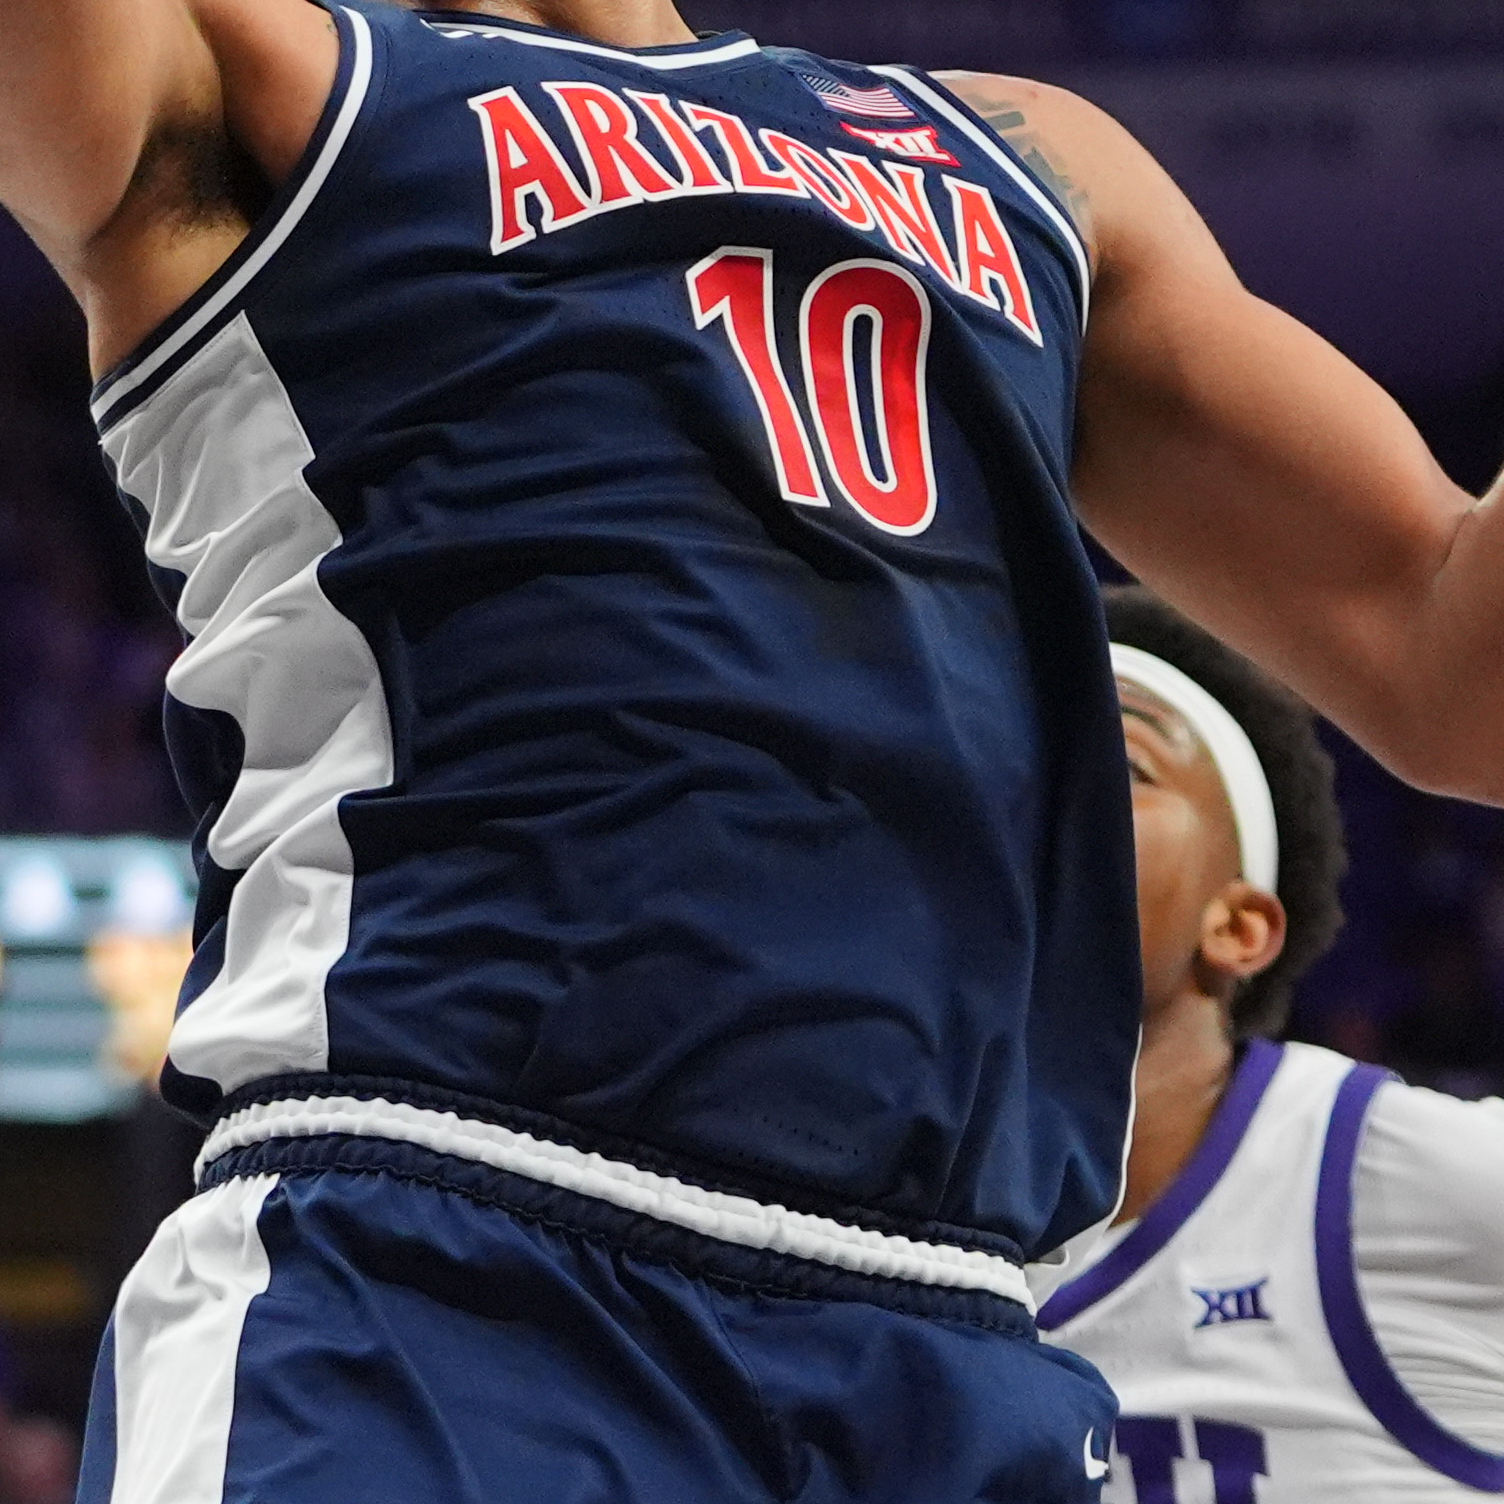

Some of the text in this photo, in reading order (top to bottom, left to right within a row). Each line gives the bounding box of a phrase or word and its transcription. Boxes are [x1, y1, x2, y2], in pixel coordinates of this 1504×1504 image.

[468, 80, 1043, 348] ARIZONA
[841, 122, 958, 165] XII
[685, 245, 937, 537] 10
[1191, 1275, 1273, 1329] XII
